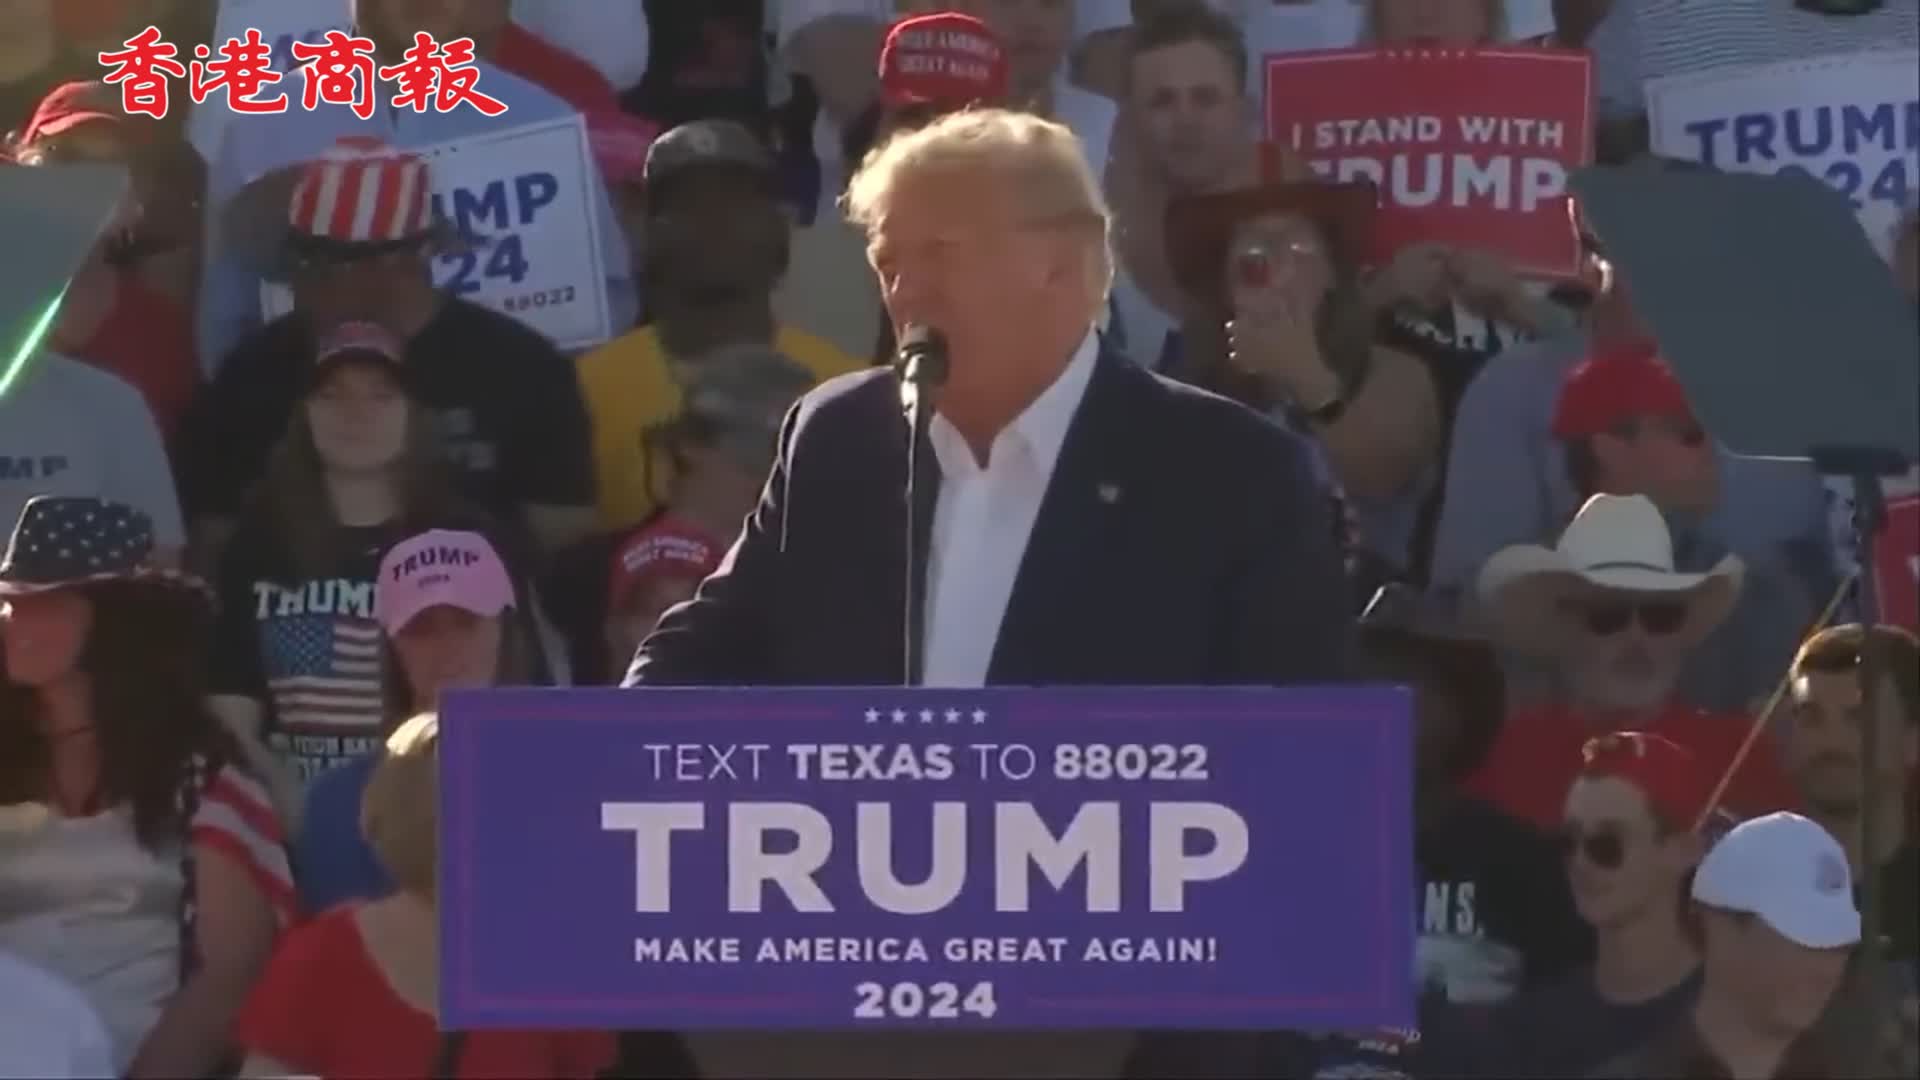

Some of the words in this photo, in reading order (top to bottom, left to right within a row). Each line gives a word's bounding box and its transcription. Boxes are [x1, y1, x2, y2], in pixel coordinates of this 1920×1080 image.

[1292, 123, 1301, 150] I
[1315, 115, 1442, 149] STAND
[1458, 116, 1564, 148] WITH
[1777, 157, 1907, 210] 24
[431, 172, 558, 240] MP
[392, 546, 480, 583] TRUMP
[643, 744, 770, 780] TEXT
[787, 743, 954, 780] TEXAS
[970, 743, 1036, 780] TO
[1053, 743, 1209, 780] 88022
[601, 801, 1250, 914] TRUMP
[635, 937, 740, 962] MAKE
[756, 937, 928, 962] AMERICA
[944, 937, 1068, 962] GREAT
[1083, 937, 1216, 962] AGAIN!
[854, 981, 997, 1018] 2024
